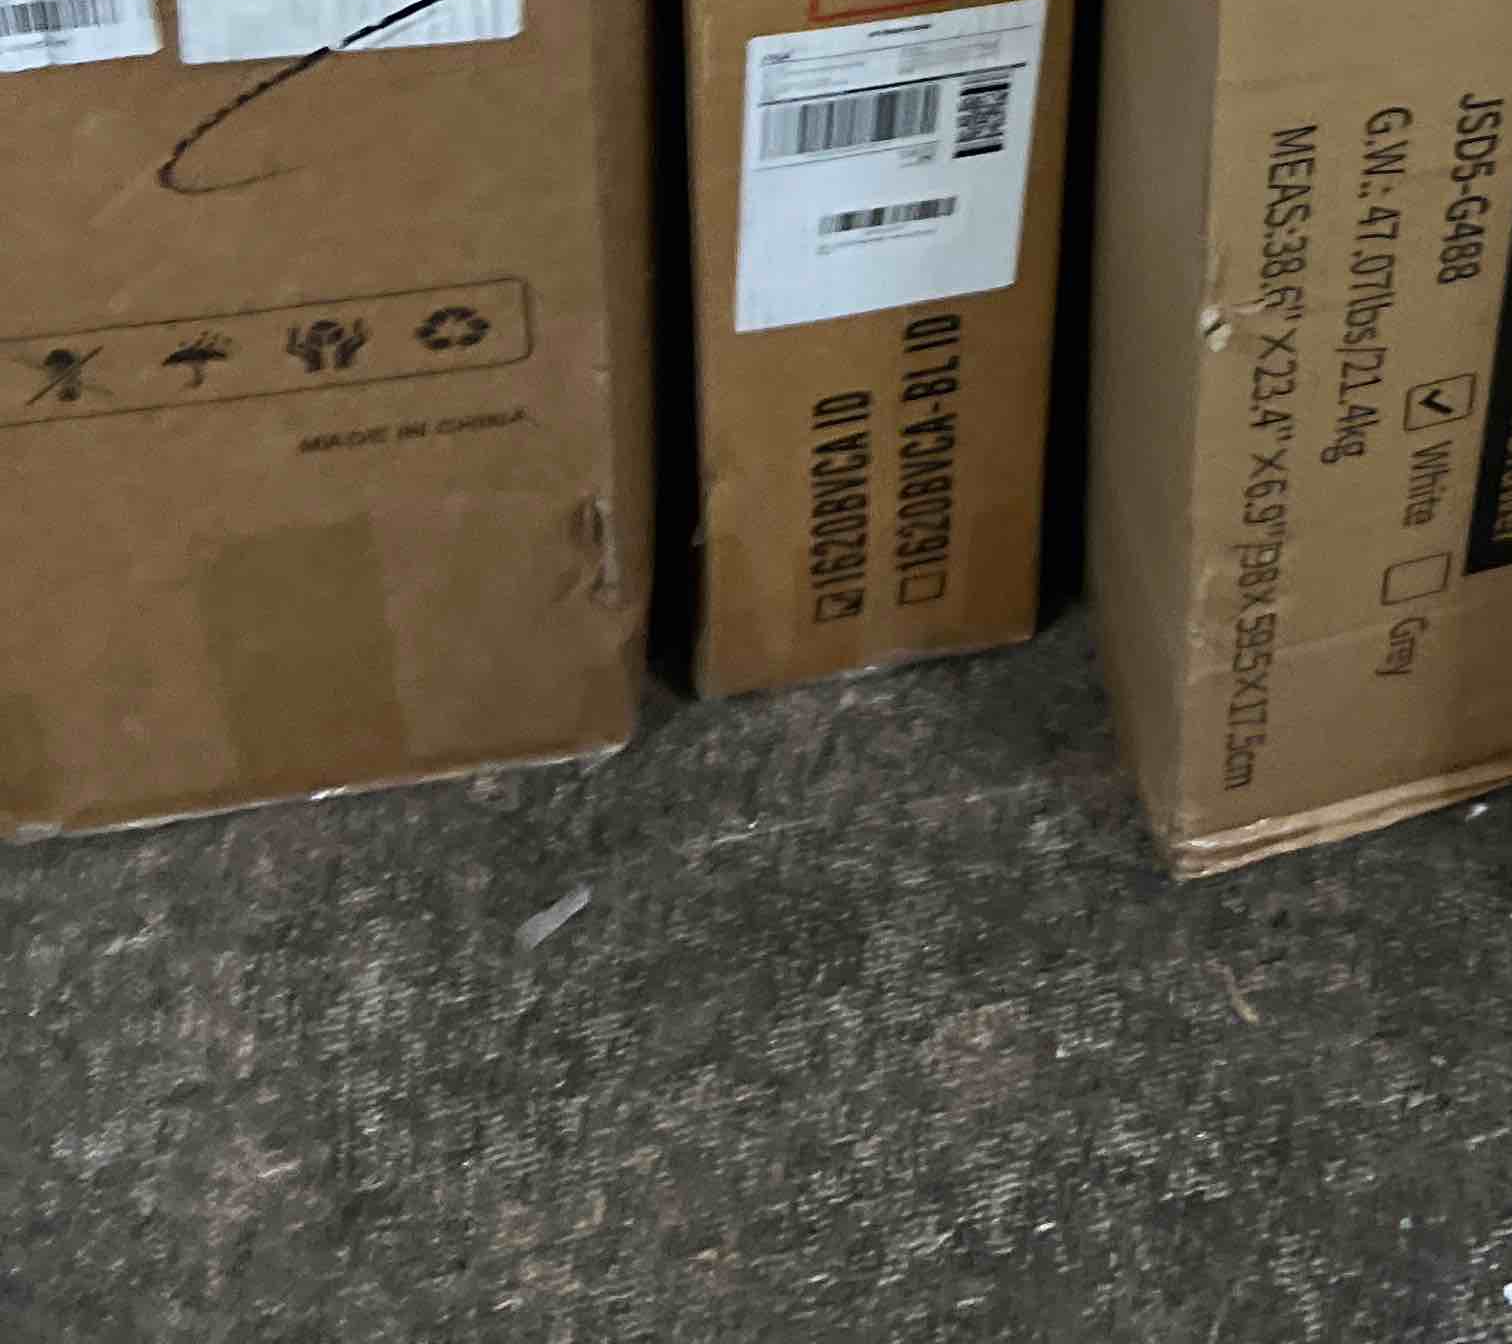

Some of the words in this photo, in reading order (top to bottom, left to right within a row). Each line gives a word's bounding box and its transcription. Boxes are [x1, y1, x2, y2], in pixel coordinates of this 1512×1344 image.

[1437, 91, 1505, 286] JSD5-G488
[1402, 439, 1453, 528] White
[1376, 614, 1431, 679] Grey
